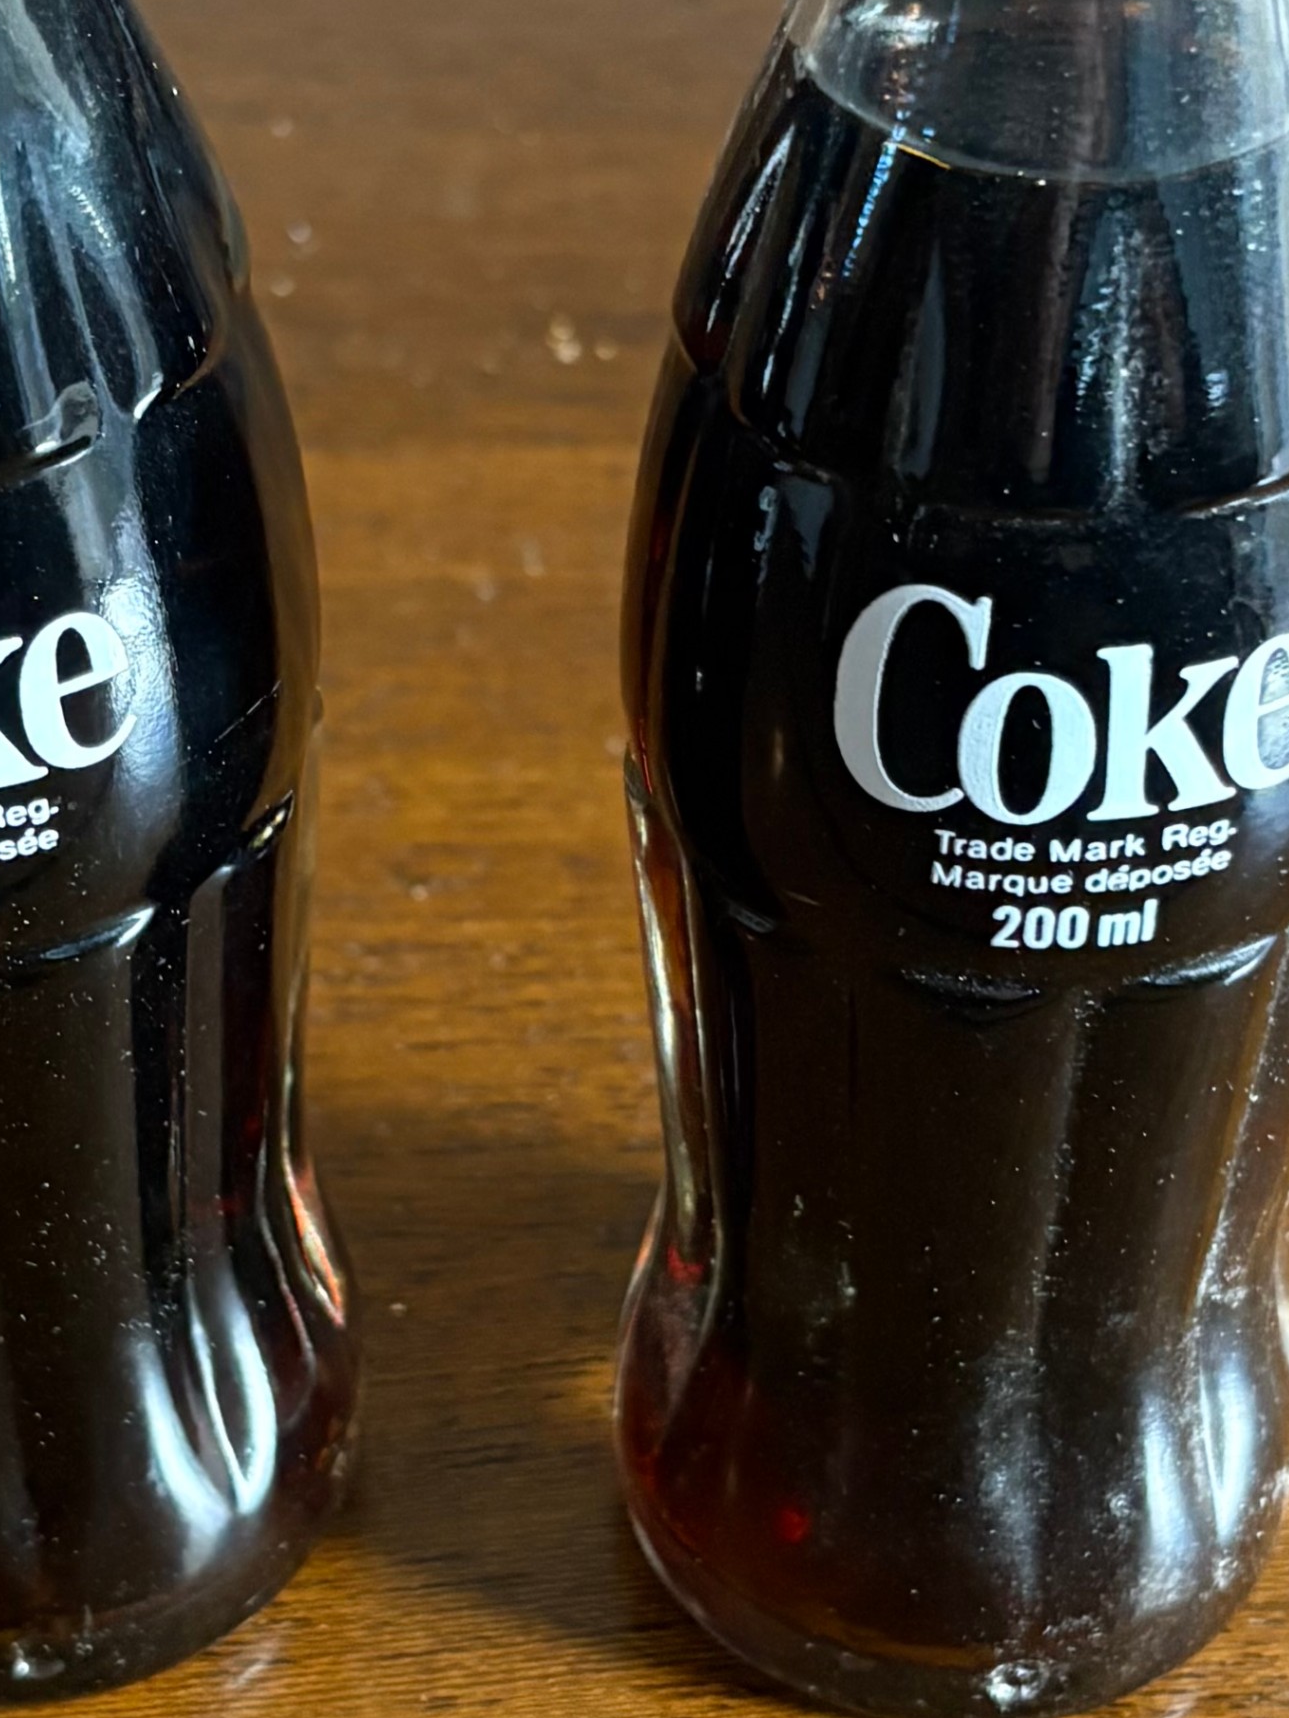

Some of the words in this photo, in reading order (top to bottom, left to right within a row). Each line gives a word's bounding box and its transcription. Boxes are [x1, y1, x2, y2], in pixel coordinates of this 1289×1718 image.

[934, 828, 1037, 863] Trade
[1048, 833, 1147, 863] Mark
[930, 860, 1074, 898] Marque
[1084, 847, 1233, 894] déposée
[989, 904, 1091, 951] 200
[1096, 897, 1160, 949] ml
